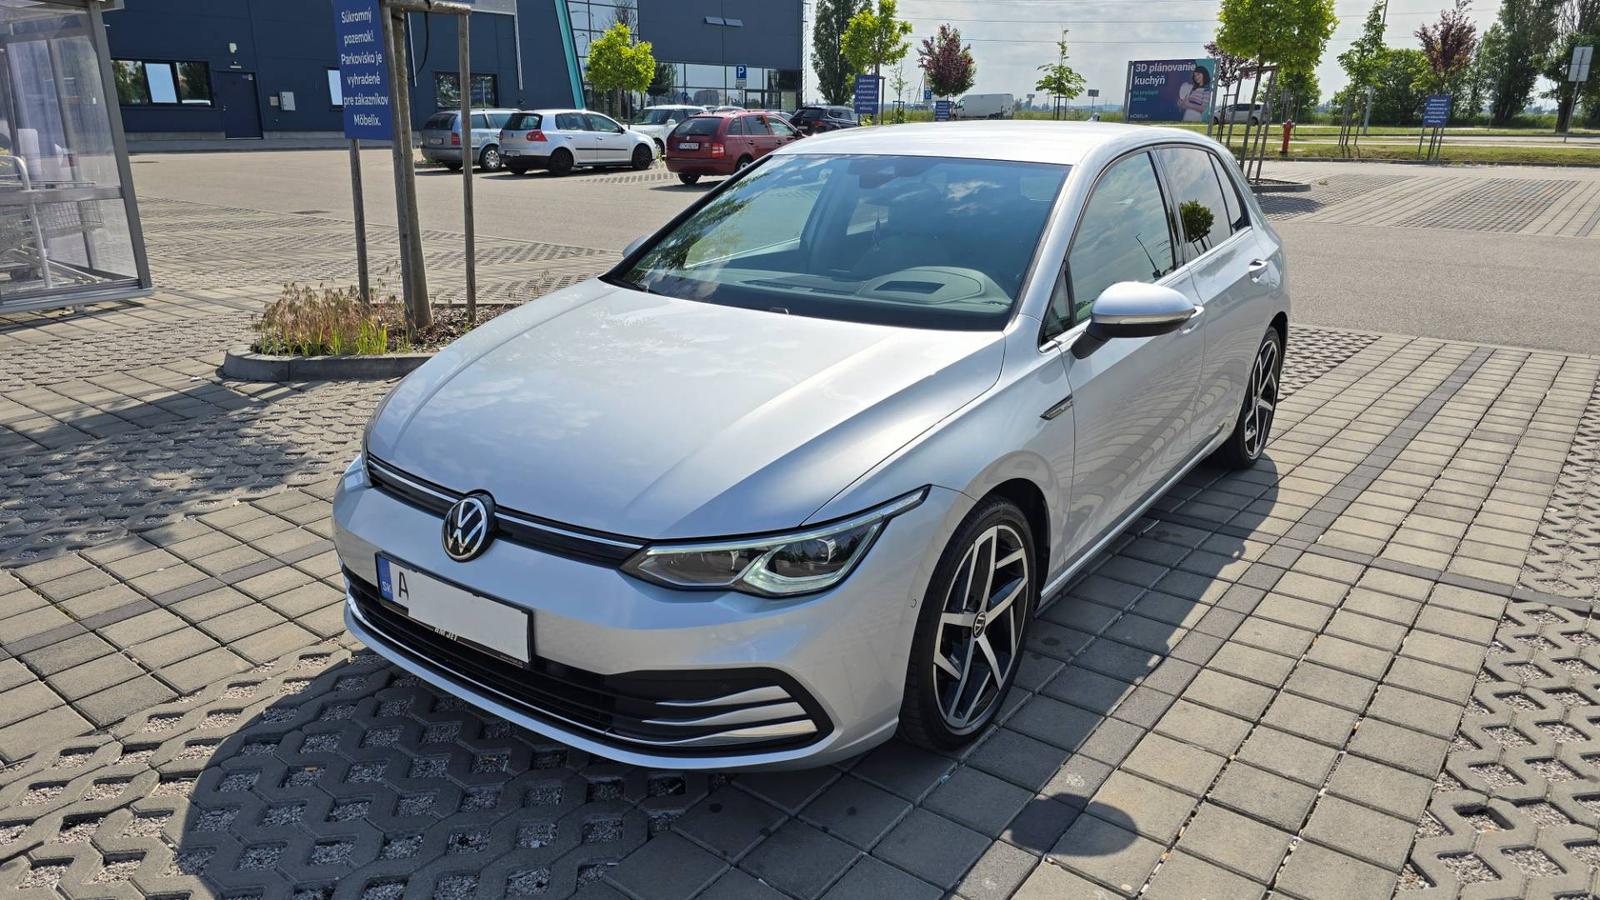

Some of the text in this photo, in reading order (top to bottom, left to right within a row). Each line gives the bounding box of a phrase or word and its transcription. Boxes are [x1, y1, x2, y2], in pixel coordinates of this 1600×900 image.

[341, 7, 372, 24] Súkromný
[344, 30, 374, 46] pozemok!
[341, 51, 382, 66] Parkovisko je
[738, 66, 744, 77] P
[1135, 62, 1196, 73] 3D plánovanie
[347, 72, 381, 88] vyhradené
[1134, 76, 1165, 86] kuchýň
[343, 92, 389, 108] pre zákazníkov
[353, 114, 382, 126] Möbelix.
[382, 580, 391, 593] SK
[398, 570, 409, 601] A
